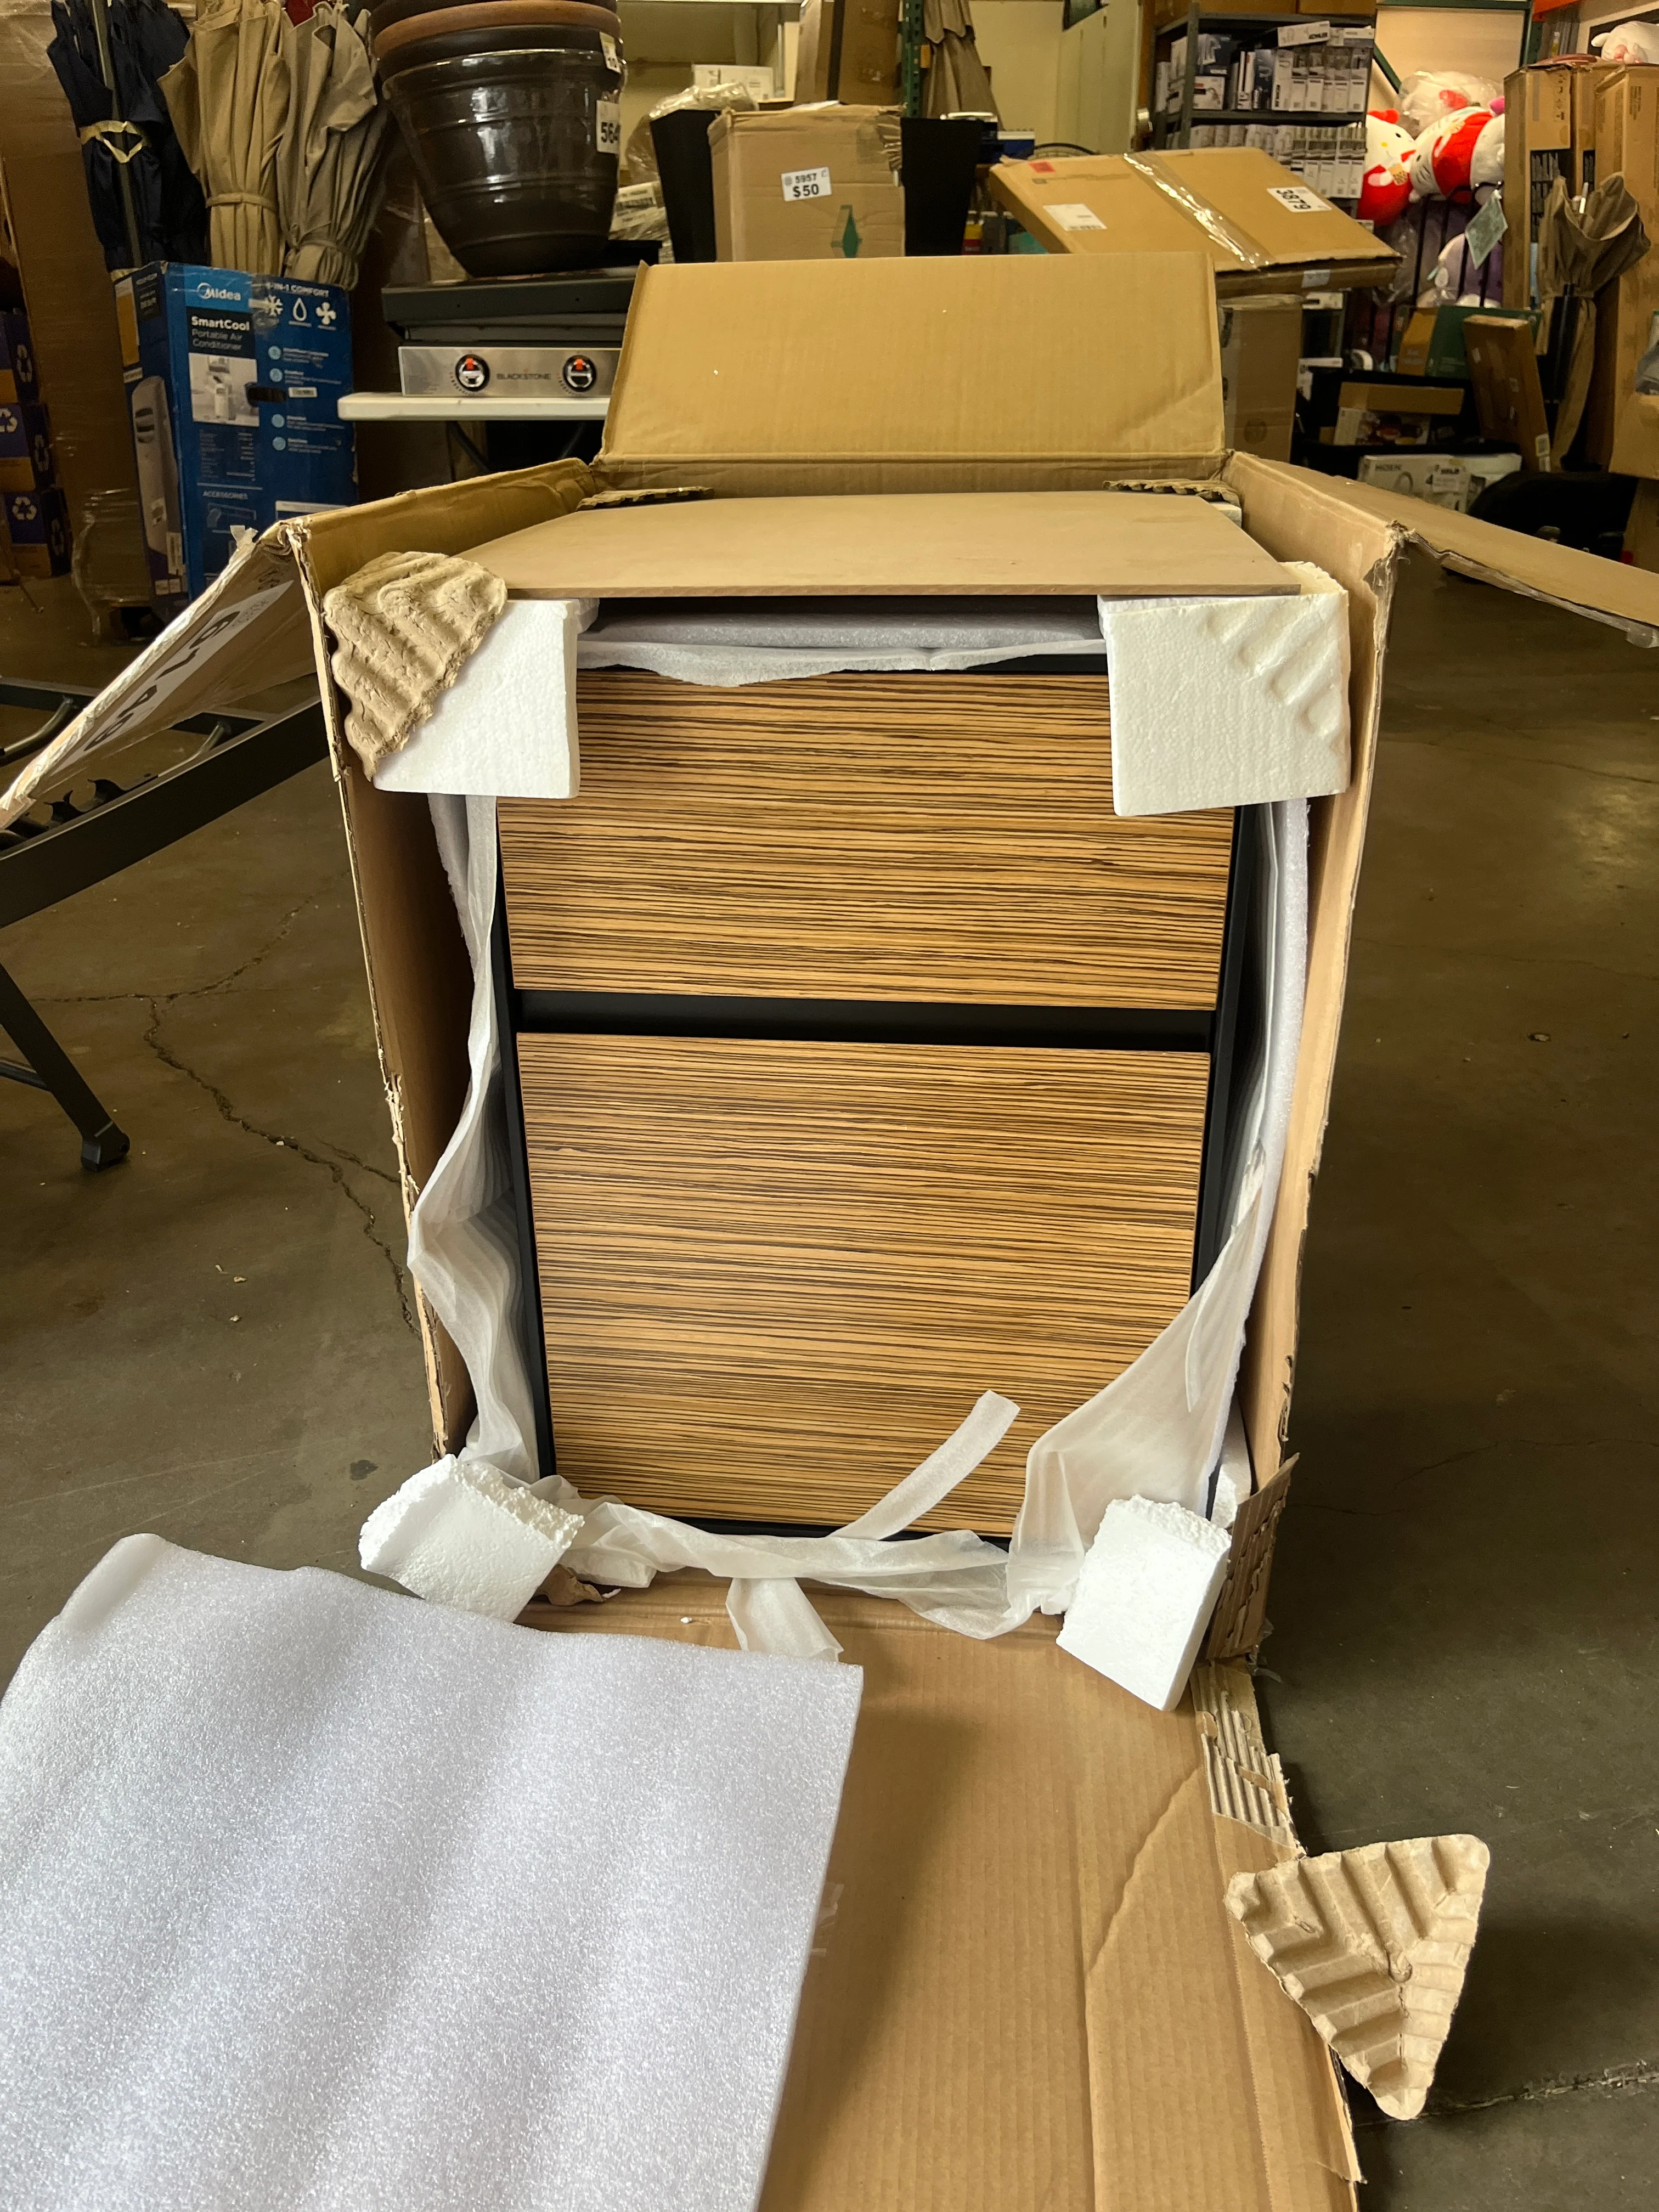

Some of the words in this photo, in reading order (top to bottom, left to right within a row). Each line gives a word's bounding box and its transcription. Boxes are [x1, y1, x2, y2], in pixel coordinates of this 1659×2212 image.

[795, 172, 817, 184] 5957
[793, 183, 819, 198] $50
[1276, 190, 1311, 209] 3879
[202, 286, 241, 301] Midea
[191, 315, 250, 331] SmartCool
